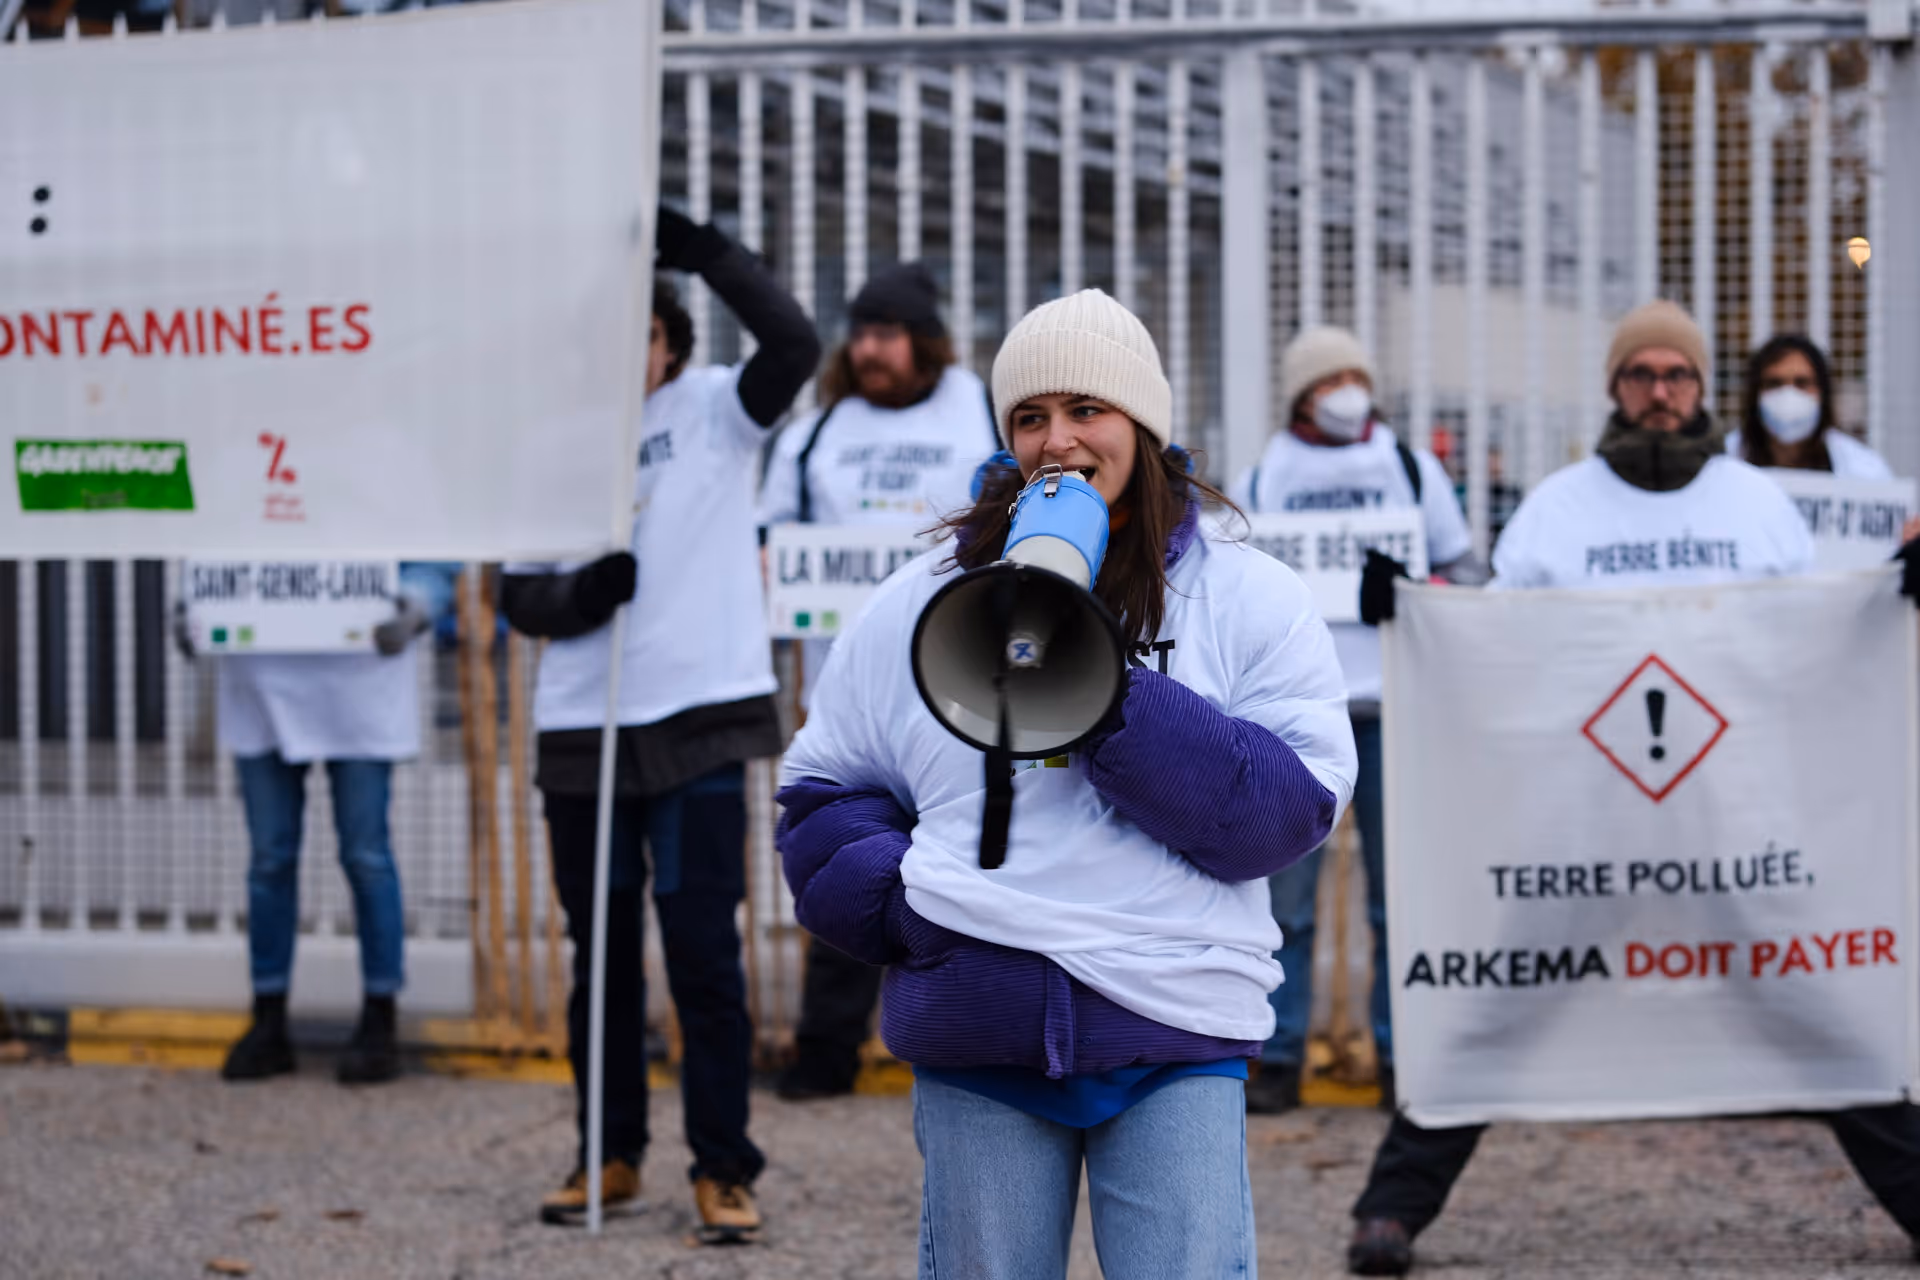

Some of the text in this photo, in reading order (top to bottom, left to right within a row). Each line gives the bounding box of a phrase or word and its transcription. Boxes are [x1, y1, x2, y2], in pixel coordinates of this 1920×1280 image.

[778, 546, 930, 584] LA MULA
[1317, 523, 1412, 570] BÉTE
[1586, 524, 1739, 574] PIERRE BÉNITE
[1489, 840, 1815, 899] TERRE POLLUÉE,
[1404, 927, 1898, 989] ARKEMA DOIT PAYER
